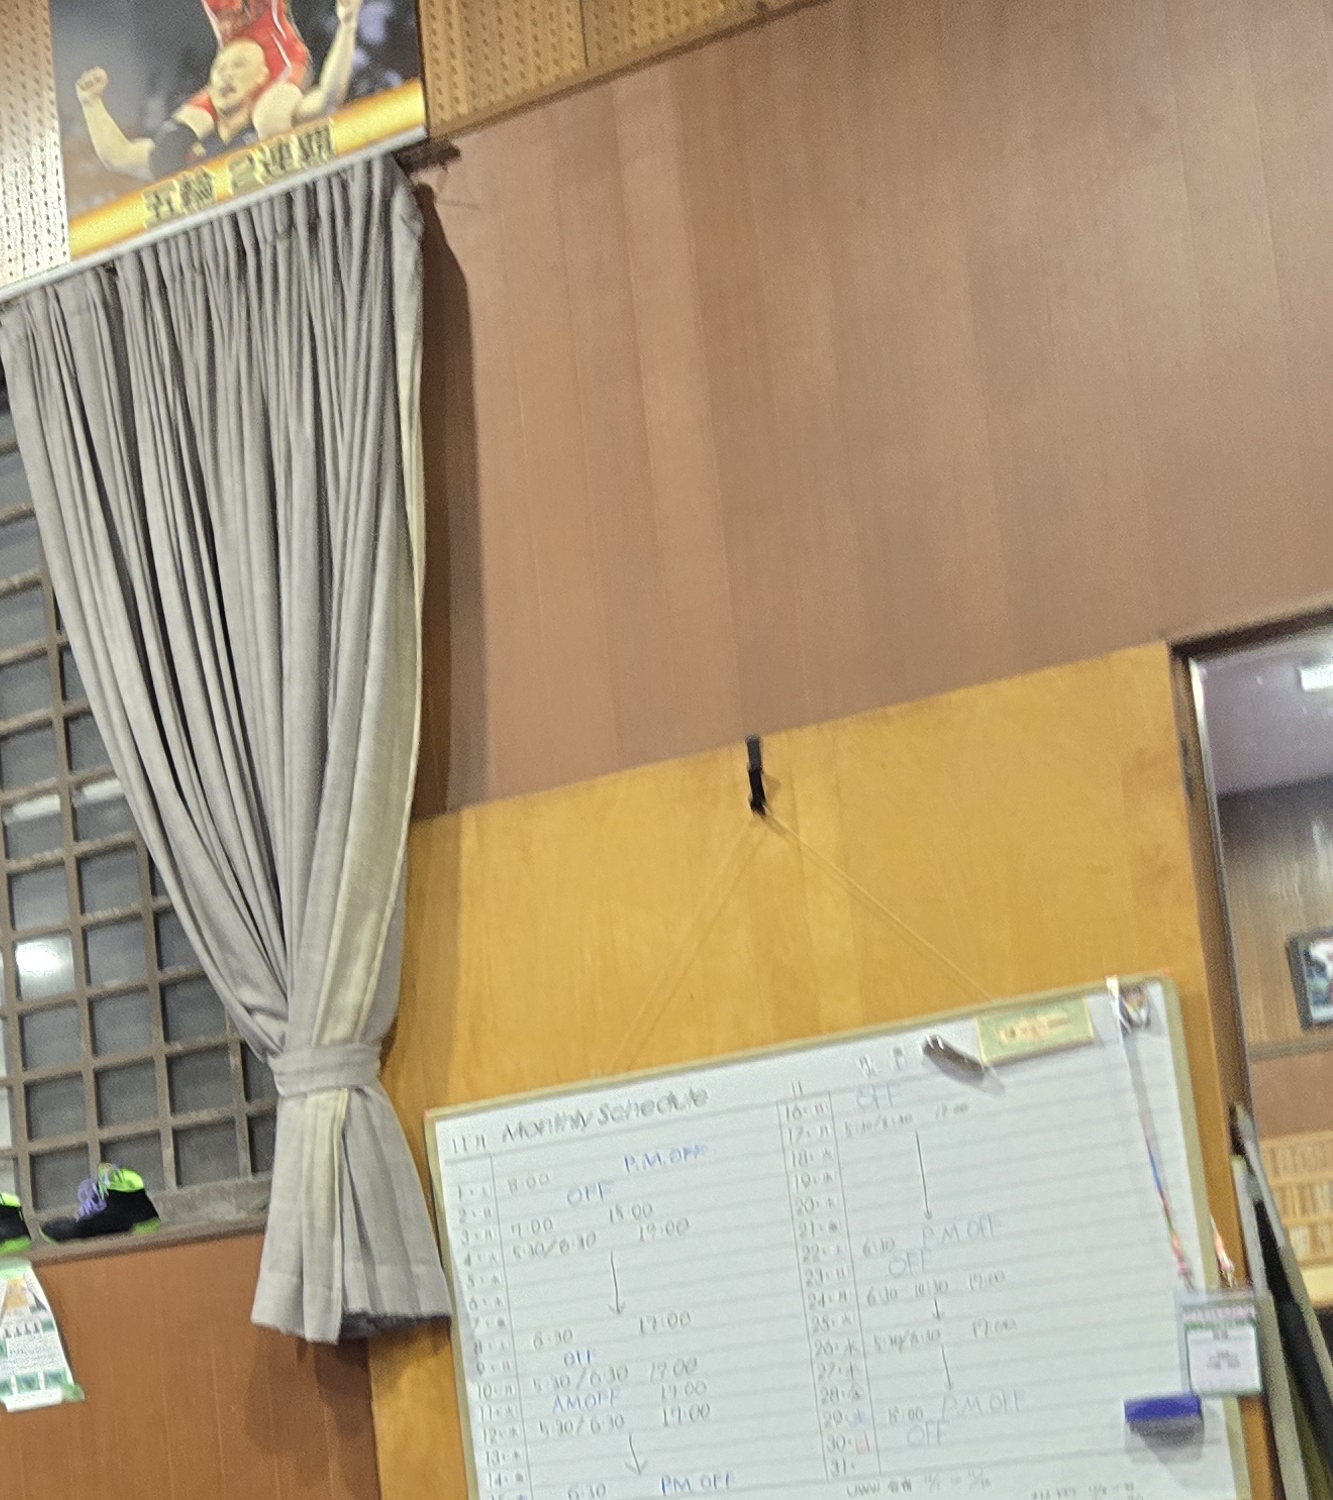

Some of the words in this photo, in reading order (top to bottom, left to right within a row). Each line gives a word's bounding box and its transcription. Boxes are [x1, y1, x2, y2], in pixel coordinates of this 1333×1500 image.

[499, 1105, 593, 1147] Monthly
[595, 1084, 709, 1127] Schedule
[886, 1247, 934, 1278] OFF
[905, 1418, 952, 1448] OFF
